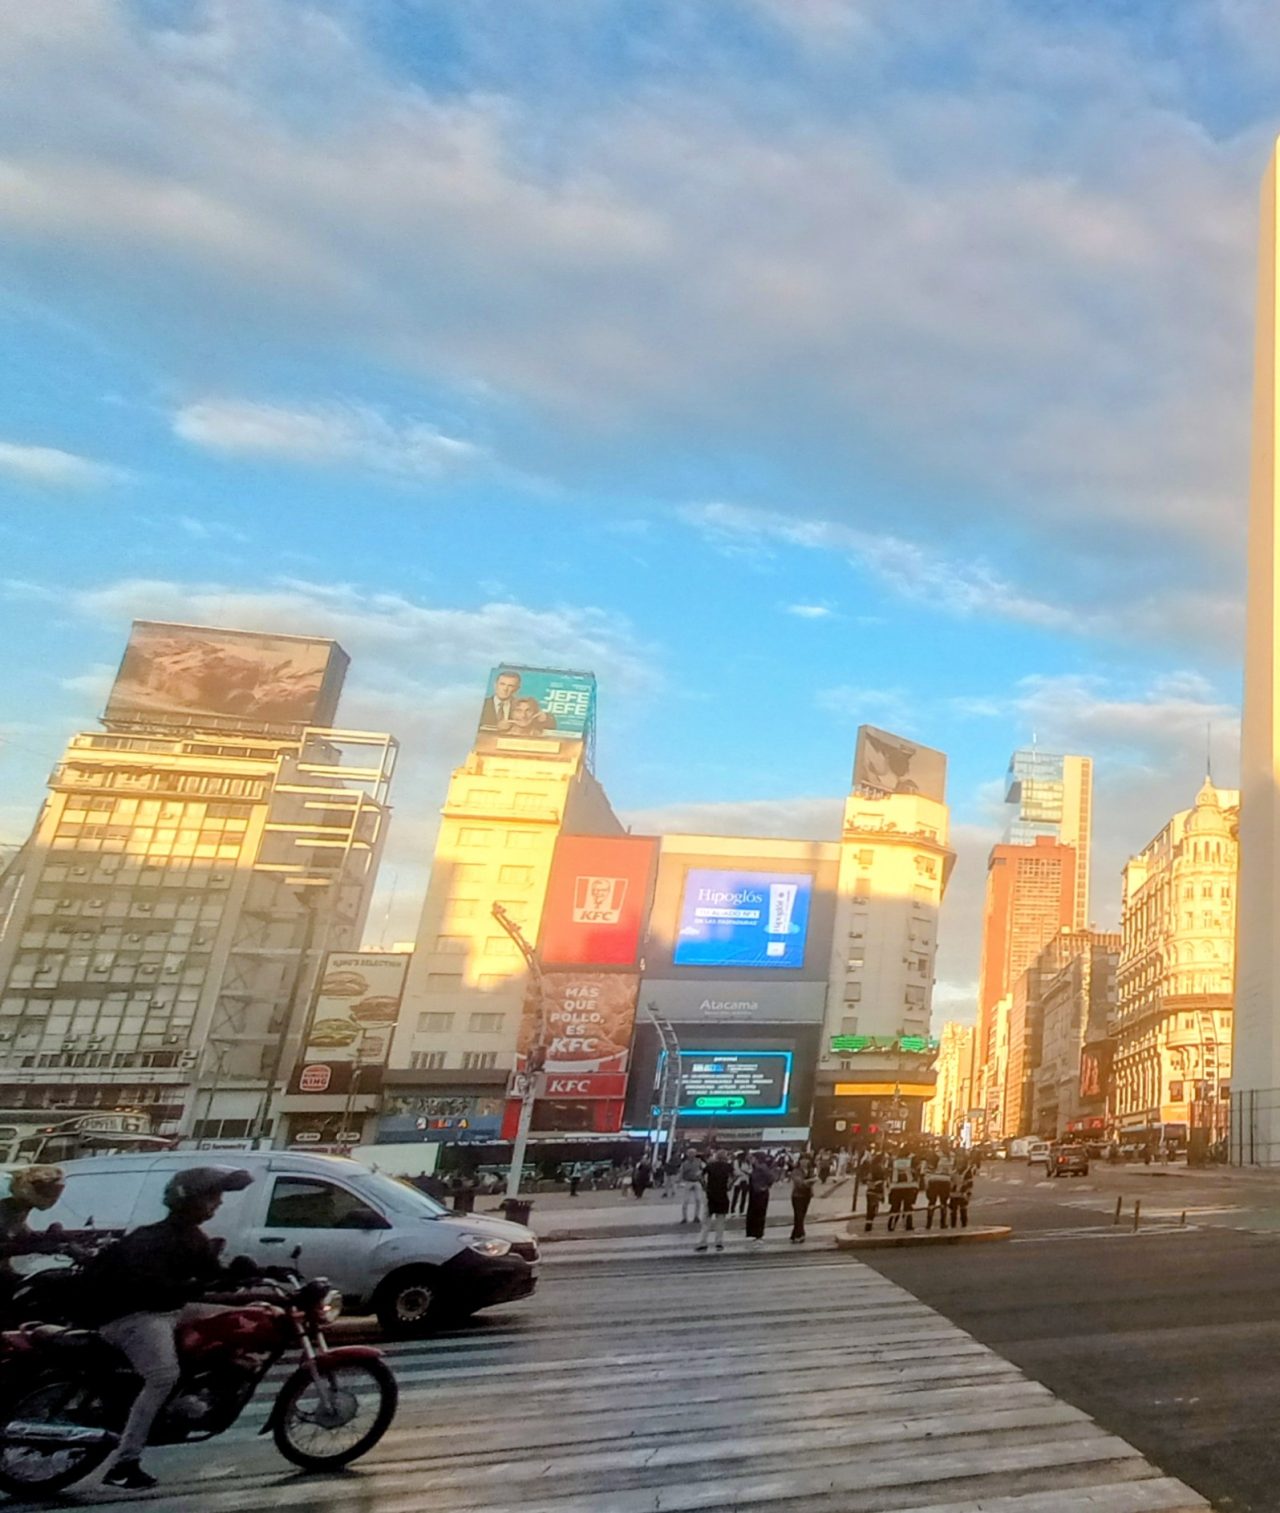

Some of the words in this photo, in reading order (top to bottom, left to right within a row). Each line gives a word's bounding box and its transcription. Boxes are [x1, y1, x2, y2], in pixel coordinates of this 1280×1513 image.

[544, 688, 590, 704] JEFE
[541, 700, 587, 716] JEFE
[698, 888, 764, 906] Hipoglós
[580, 910, 614, 921] KFC
[565, 985, 600, 998] MÁS
[563, 1000, 597, 1012] QUE
[699, 999, 759, 1011] Atacama
[550, 1012, 606, 1024] POLLO,
[565, 1025, 586, 1036] ES
[549, 1037, 600, 1054] KFC
[548, 1079, 592, 1093] KFC
